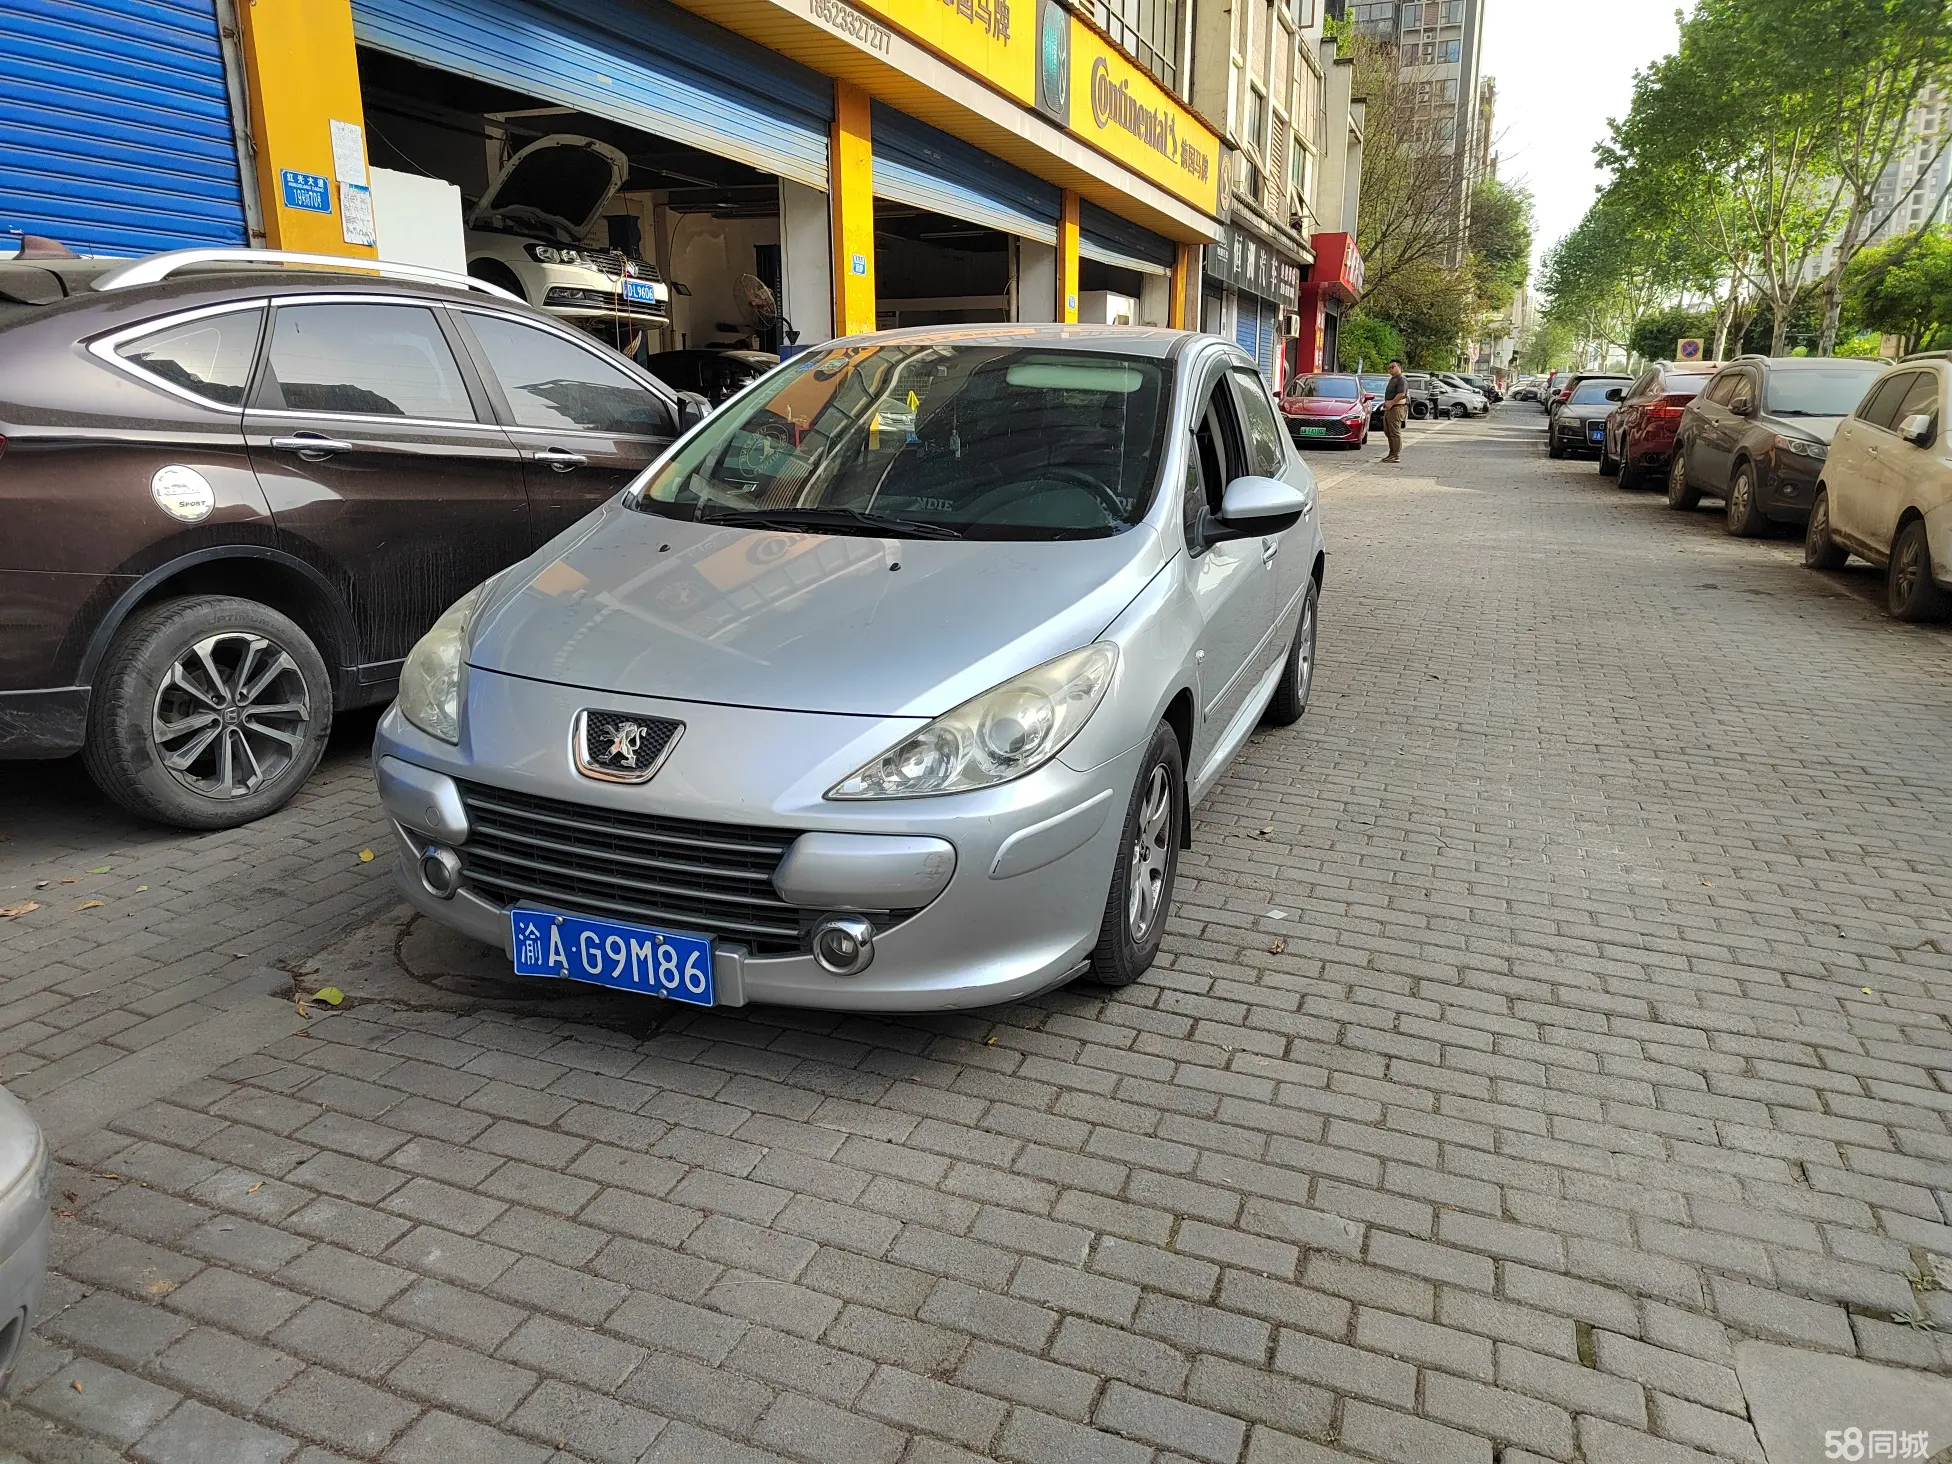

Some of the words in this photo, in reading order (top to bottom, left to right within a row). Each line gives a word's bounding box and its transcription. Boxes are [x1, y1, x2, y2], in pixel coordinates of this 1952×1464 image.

[1091, 56, 1169, 155] Continental
[1180, 137, 1208, 184] 德国马牌
[518, 922, 706, 994] 渝A·G9M86
